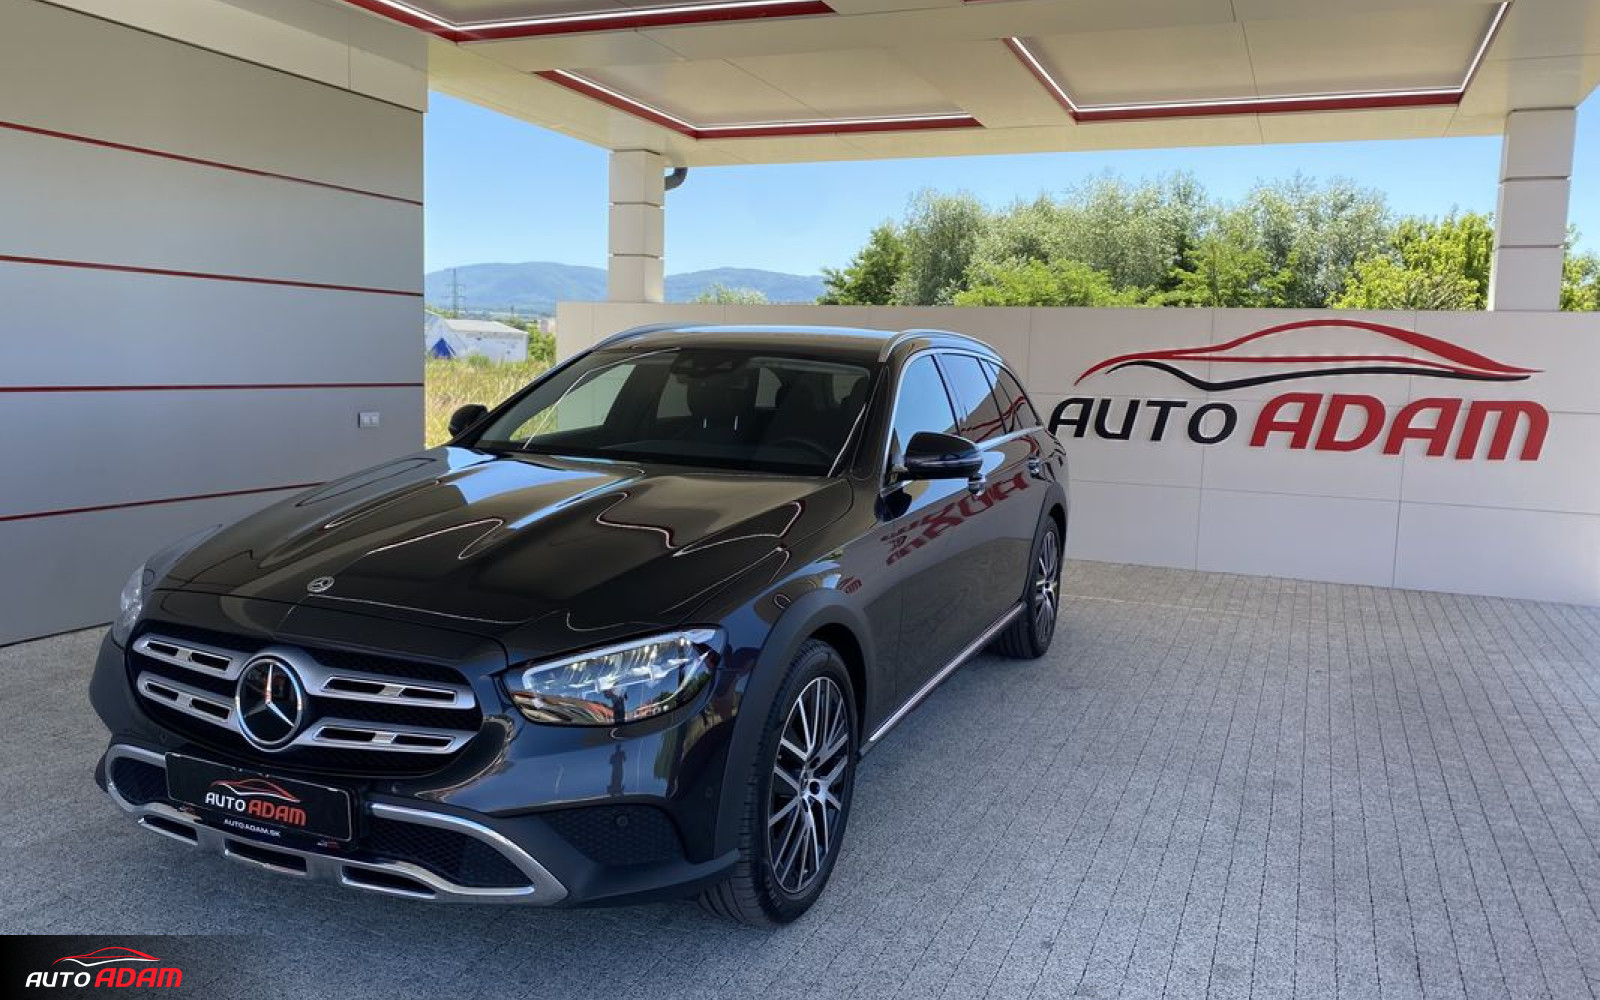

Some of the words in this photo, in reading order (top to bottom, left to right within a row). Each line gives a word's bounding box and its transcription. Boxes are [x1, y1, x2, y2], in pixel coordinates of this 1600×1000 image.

[1048, 397, 1238, 444] AUTO
[1249, 392, 1550, 461] ADAM
[205, 792, 246, 811] AUTO
[248, 799, 306, 826] ADAM
